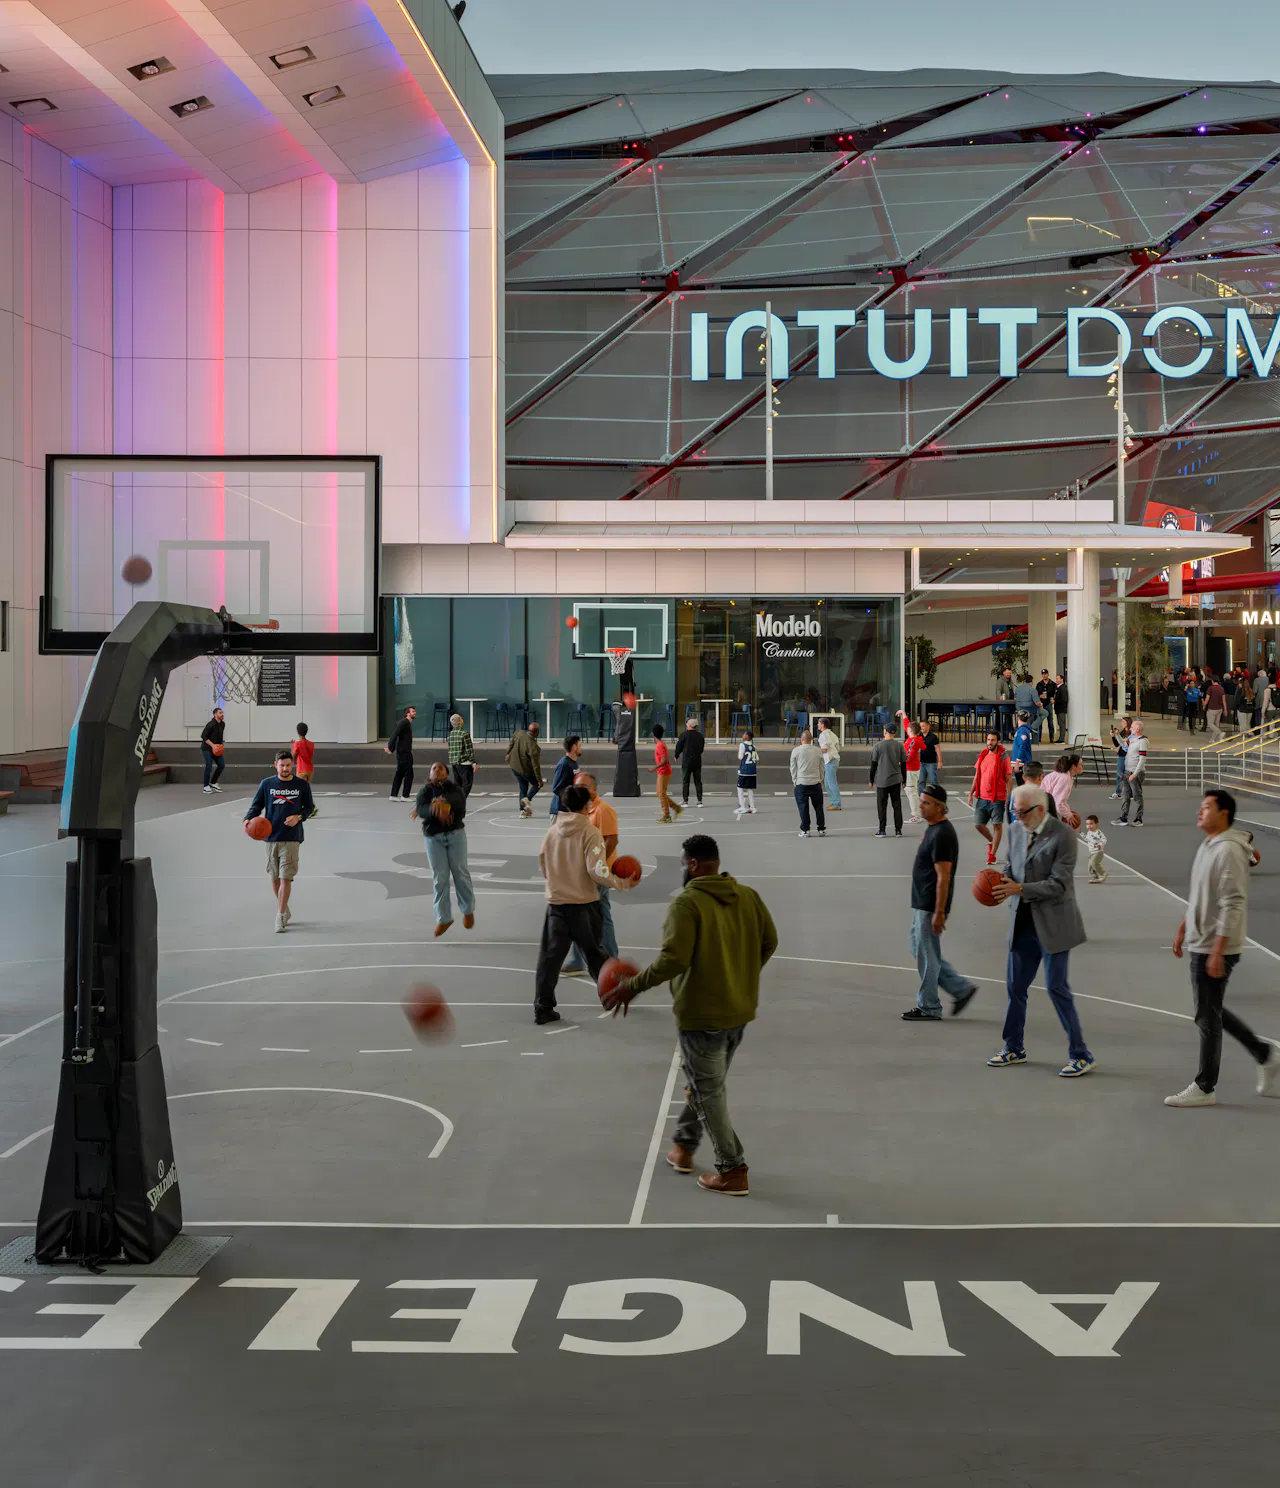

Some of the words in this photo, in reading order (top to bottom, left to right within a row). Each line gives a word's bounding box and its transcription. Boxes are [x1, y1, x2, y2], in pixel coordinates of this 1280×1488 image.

[690, 307, 1038, 381] INTUIT
[756, 614, 821, 637] Modelo
[762, 641, 816, 657] Cantina
[134, 677, 163, 766] SPALDING
[270, 788, 300, 796] Reebok
[146, 1161, 178, 1212] SPALDING
